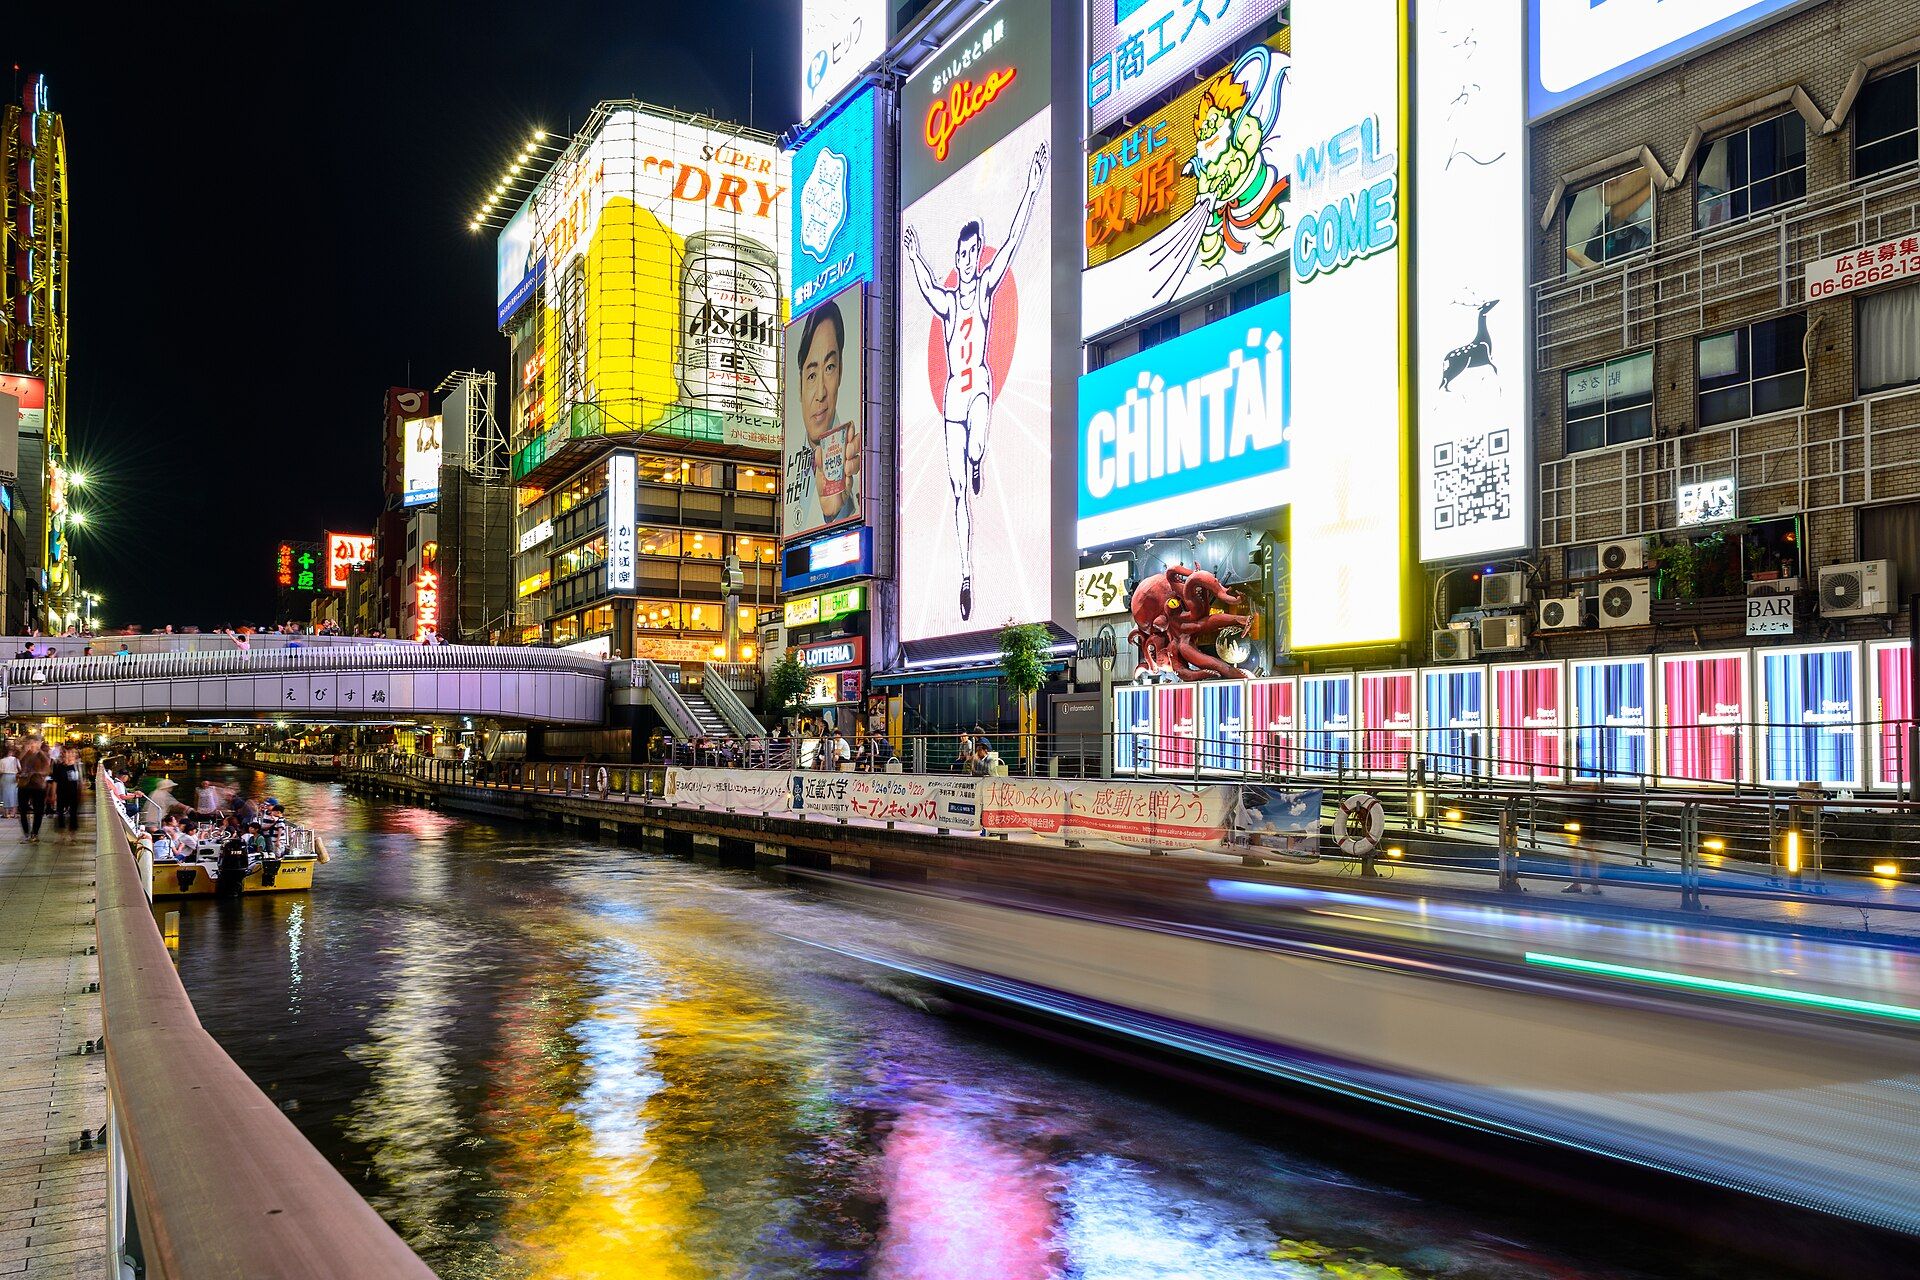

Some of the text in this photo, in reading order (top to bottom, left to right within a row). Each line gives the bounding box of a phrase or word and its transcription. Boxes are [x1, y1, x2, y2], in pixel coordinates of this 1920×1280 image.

[1088, 0, 1231, 109] 日商エス
[926, 66, 1016, 162] Glico
[699, 145, 772, 177] SUPER
[1090, 120, 1168, 187] かぜに
[1295, 112, 1395, 193] WEL
[1085, 148, 1181, 250] 改源
[1294, 178, 1394, 277] COME
[1836, 237, 1919, 273] 広告募集
[794, 251, 856, 306] 雪印メグミルク
[1810, 255, 1920, 298] 06-6262-13
[689, 297, 776, 347] Asahi
[719, 351, 746, 372] 生
[708, 371, 758, 386] スーパードライ
[725, 412, 782, 429] アサヒビール
[786, 445, 812, 478] トクホ
[785, 475, 812, 505] ガセリ
[1681, 481, 1731, 510] BAR
[1748, 599, 1792, 617] BAR
[1750, 621, 1789, 631] ふたごや
[806, 644, 850, 666] LOTTERIA
[285, 688, 387, 704] えびす橋
[1069, 704, 1095, 712] information
[805, 778, 849, 800] 近畿大学
[850, 796, 938, 820] オープンキャンパス
